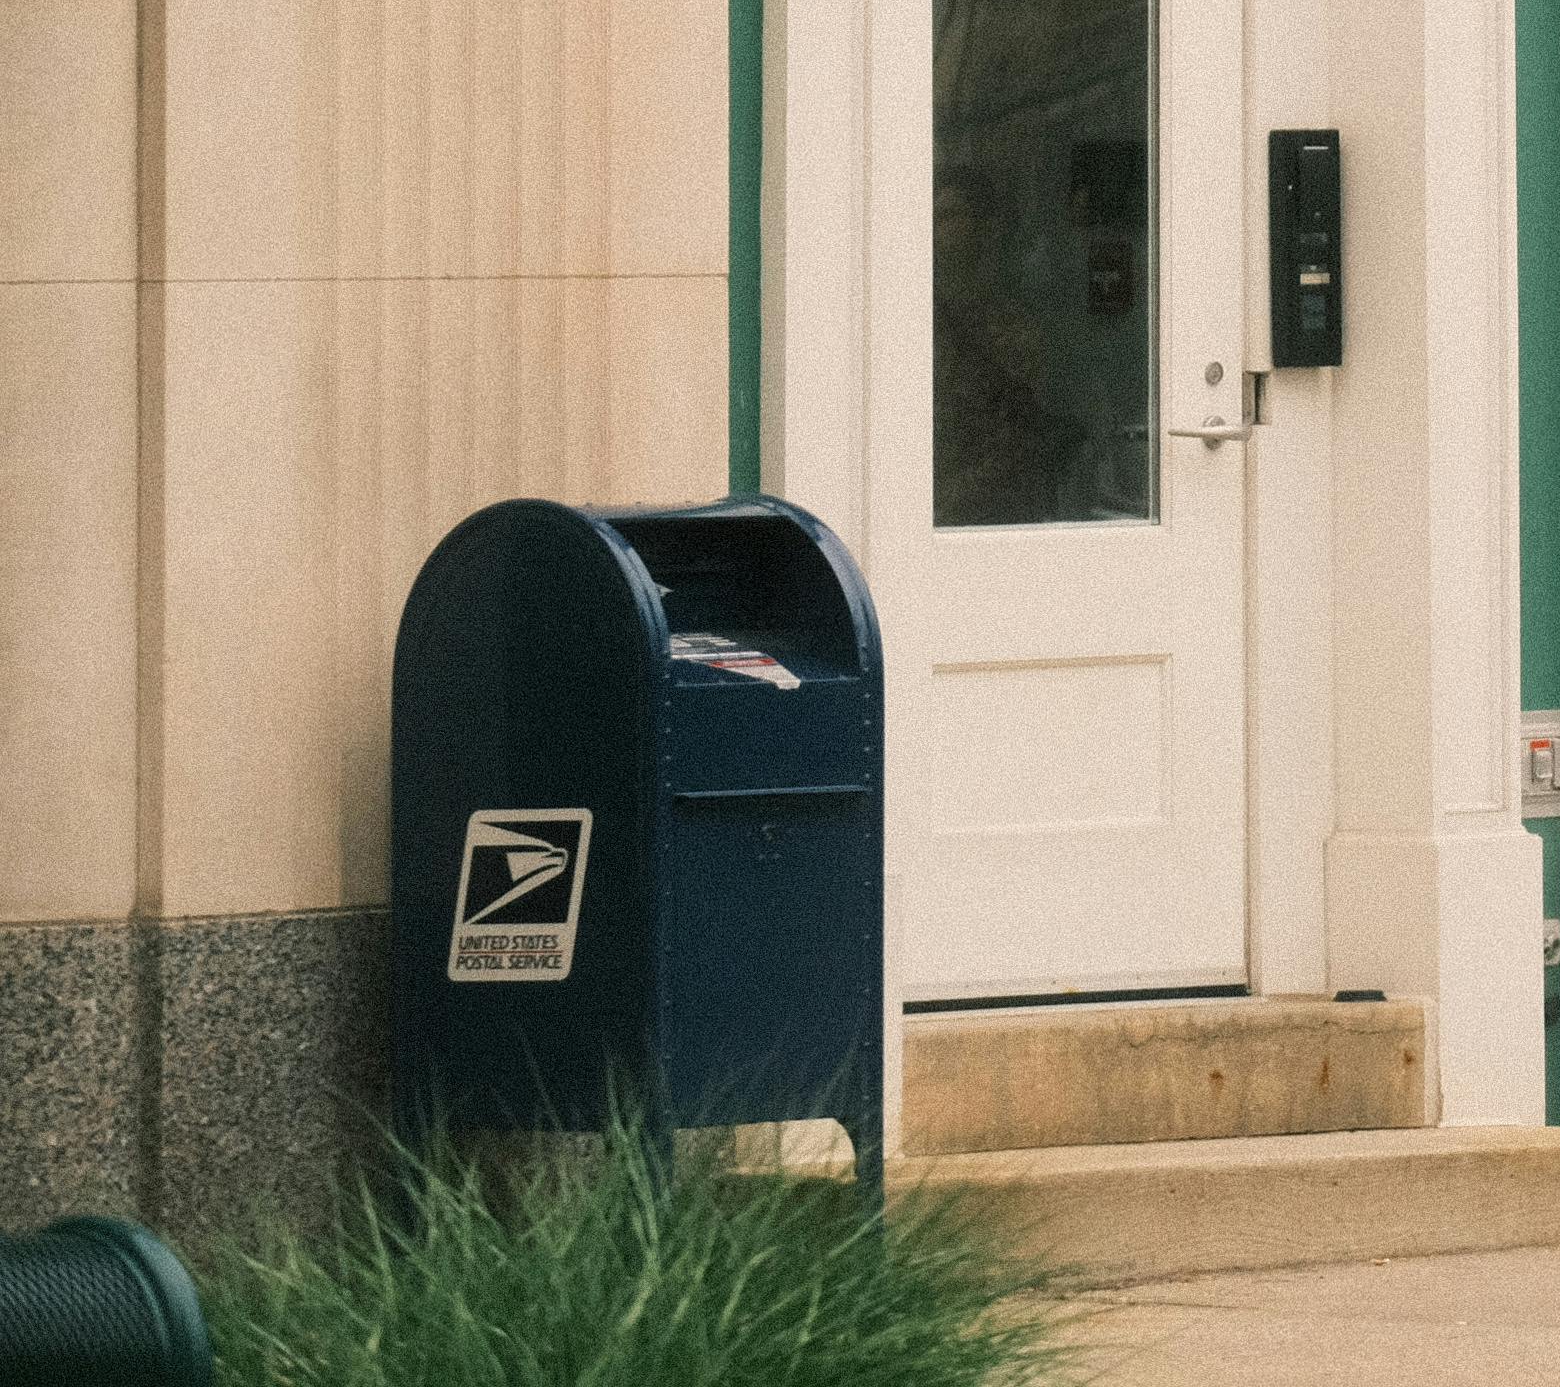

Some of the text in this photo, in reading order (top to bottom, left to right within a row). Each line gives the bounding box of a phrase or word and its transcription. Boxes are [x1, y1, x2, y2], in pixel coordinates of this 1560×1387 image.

[458, 934, 559, 950] UNITED STATES
[455, 955, 563, 971] POSTAL SERVICE
